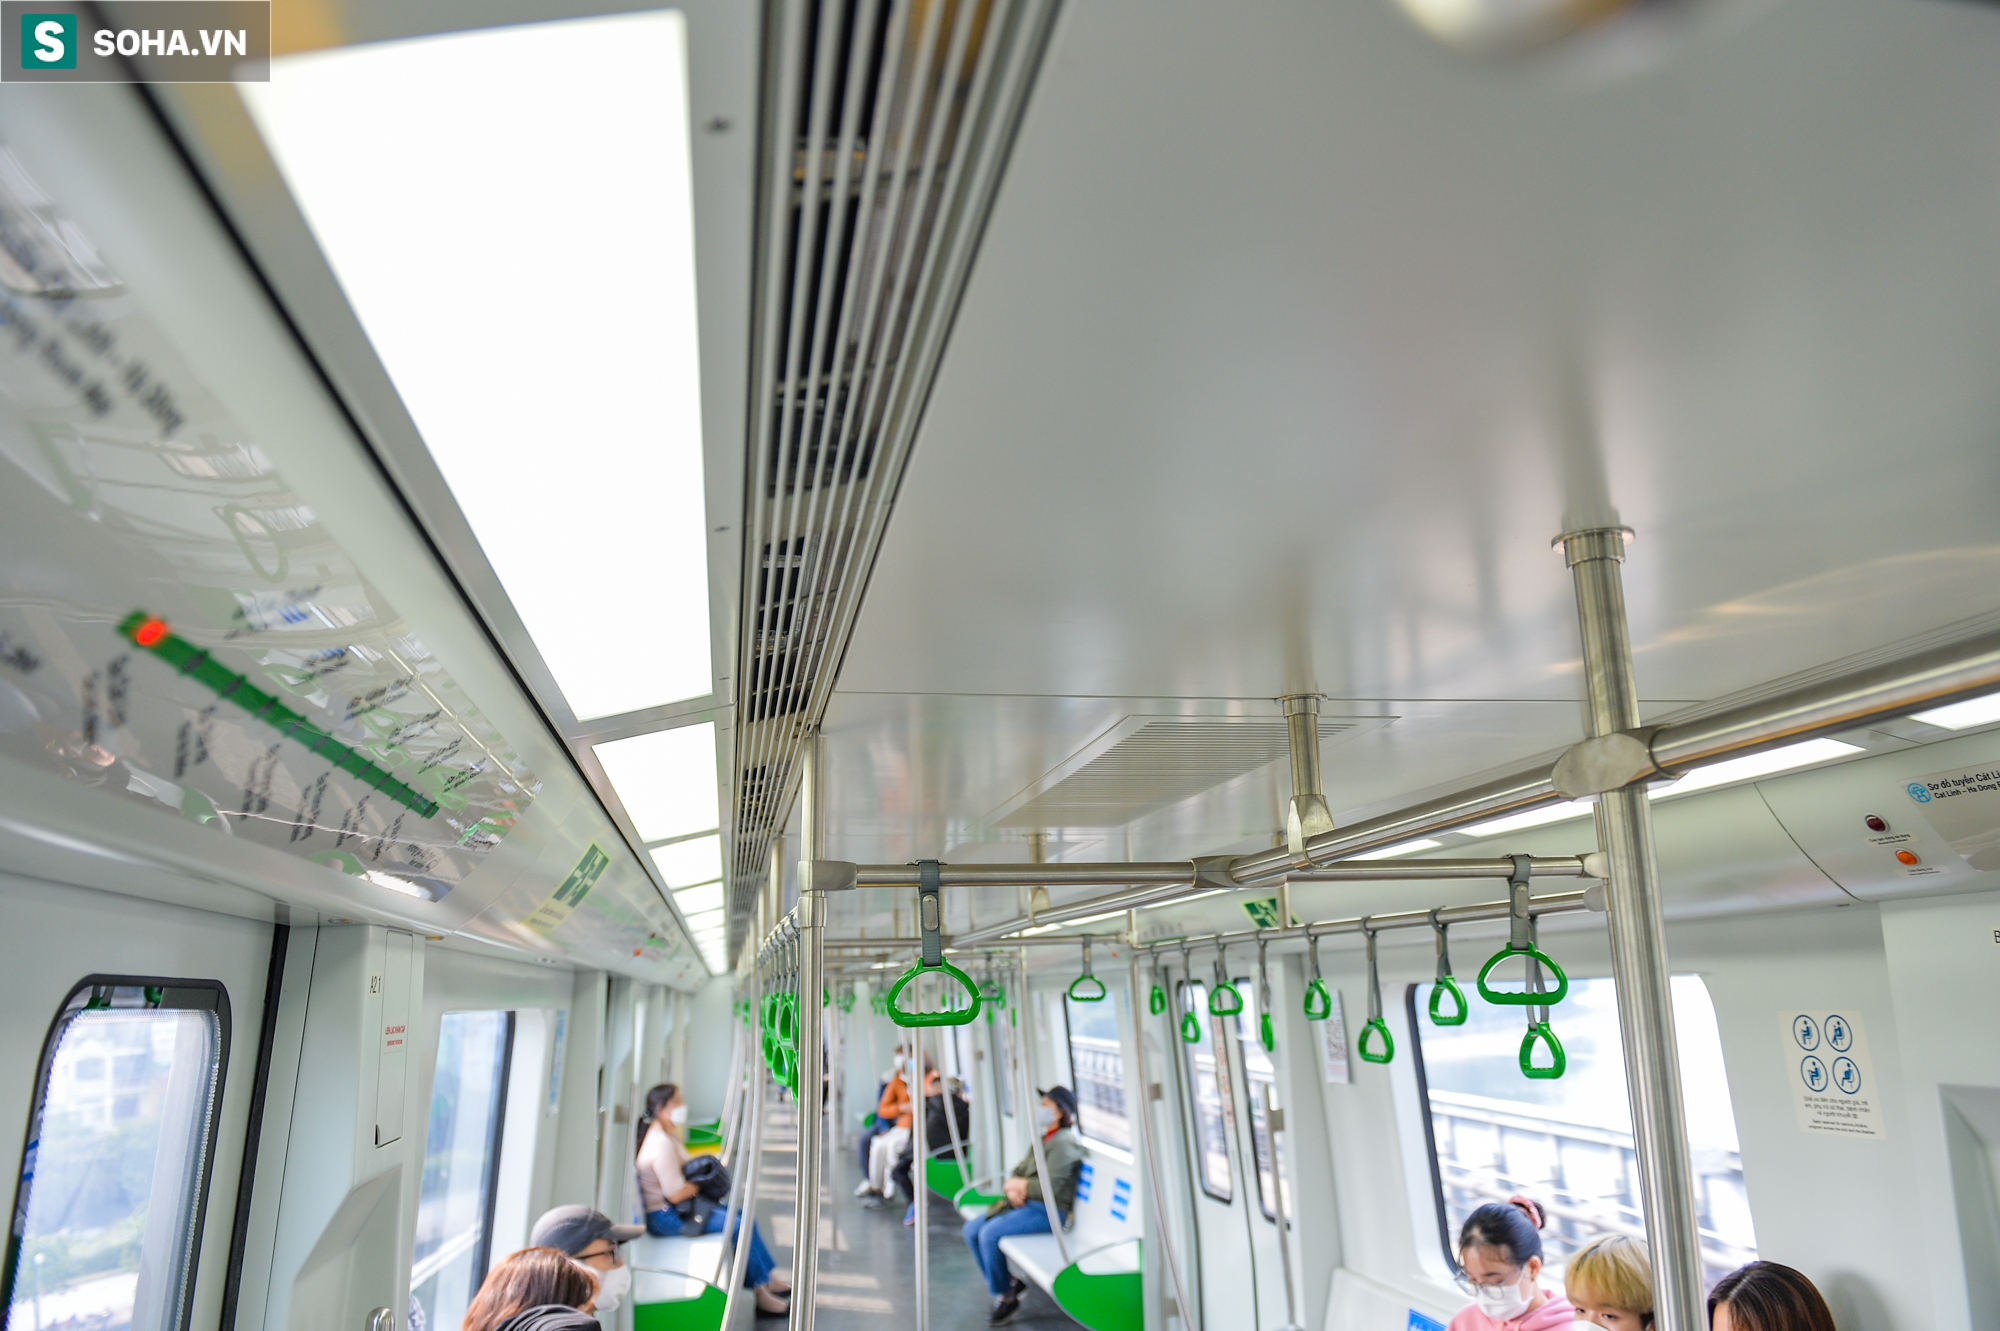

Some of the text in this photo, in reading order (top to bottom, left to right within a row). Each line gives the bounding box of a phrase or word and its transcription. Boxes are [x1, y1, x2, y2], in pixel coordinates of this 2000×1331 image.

[1991, 770, 2000, 779] Li
[1946, 789, 1962, 797] Linh
[1977, 783, 1998, 792] Dong
